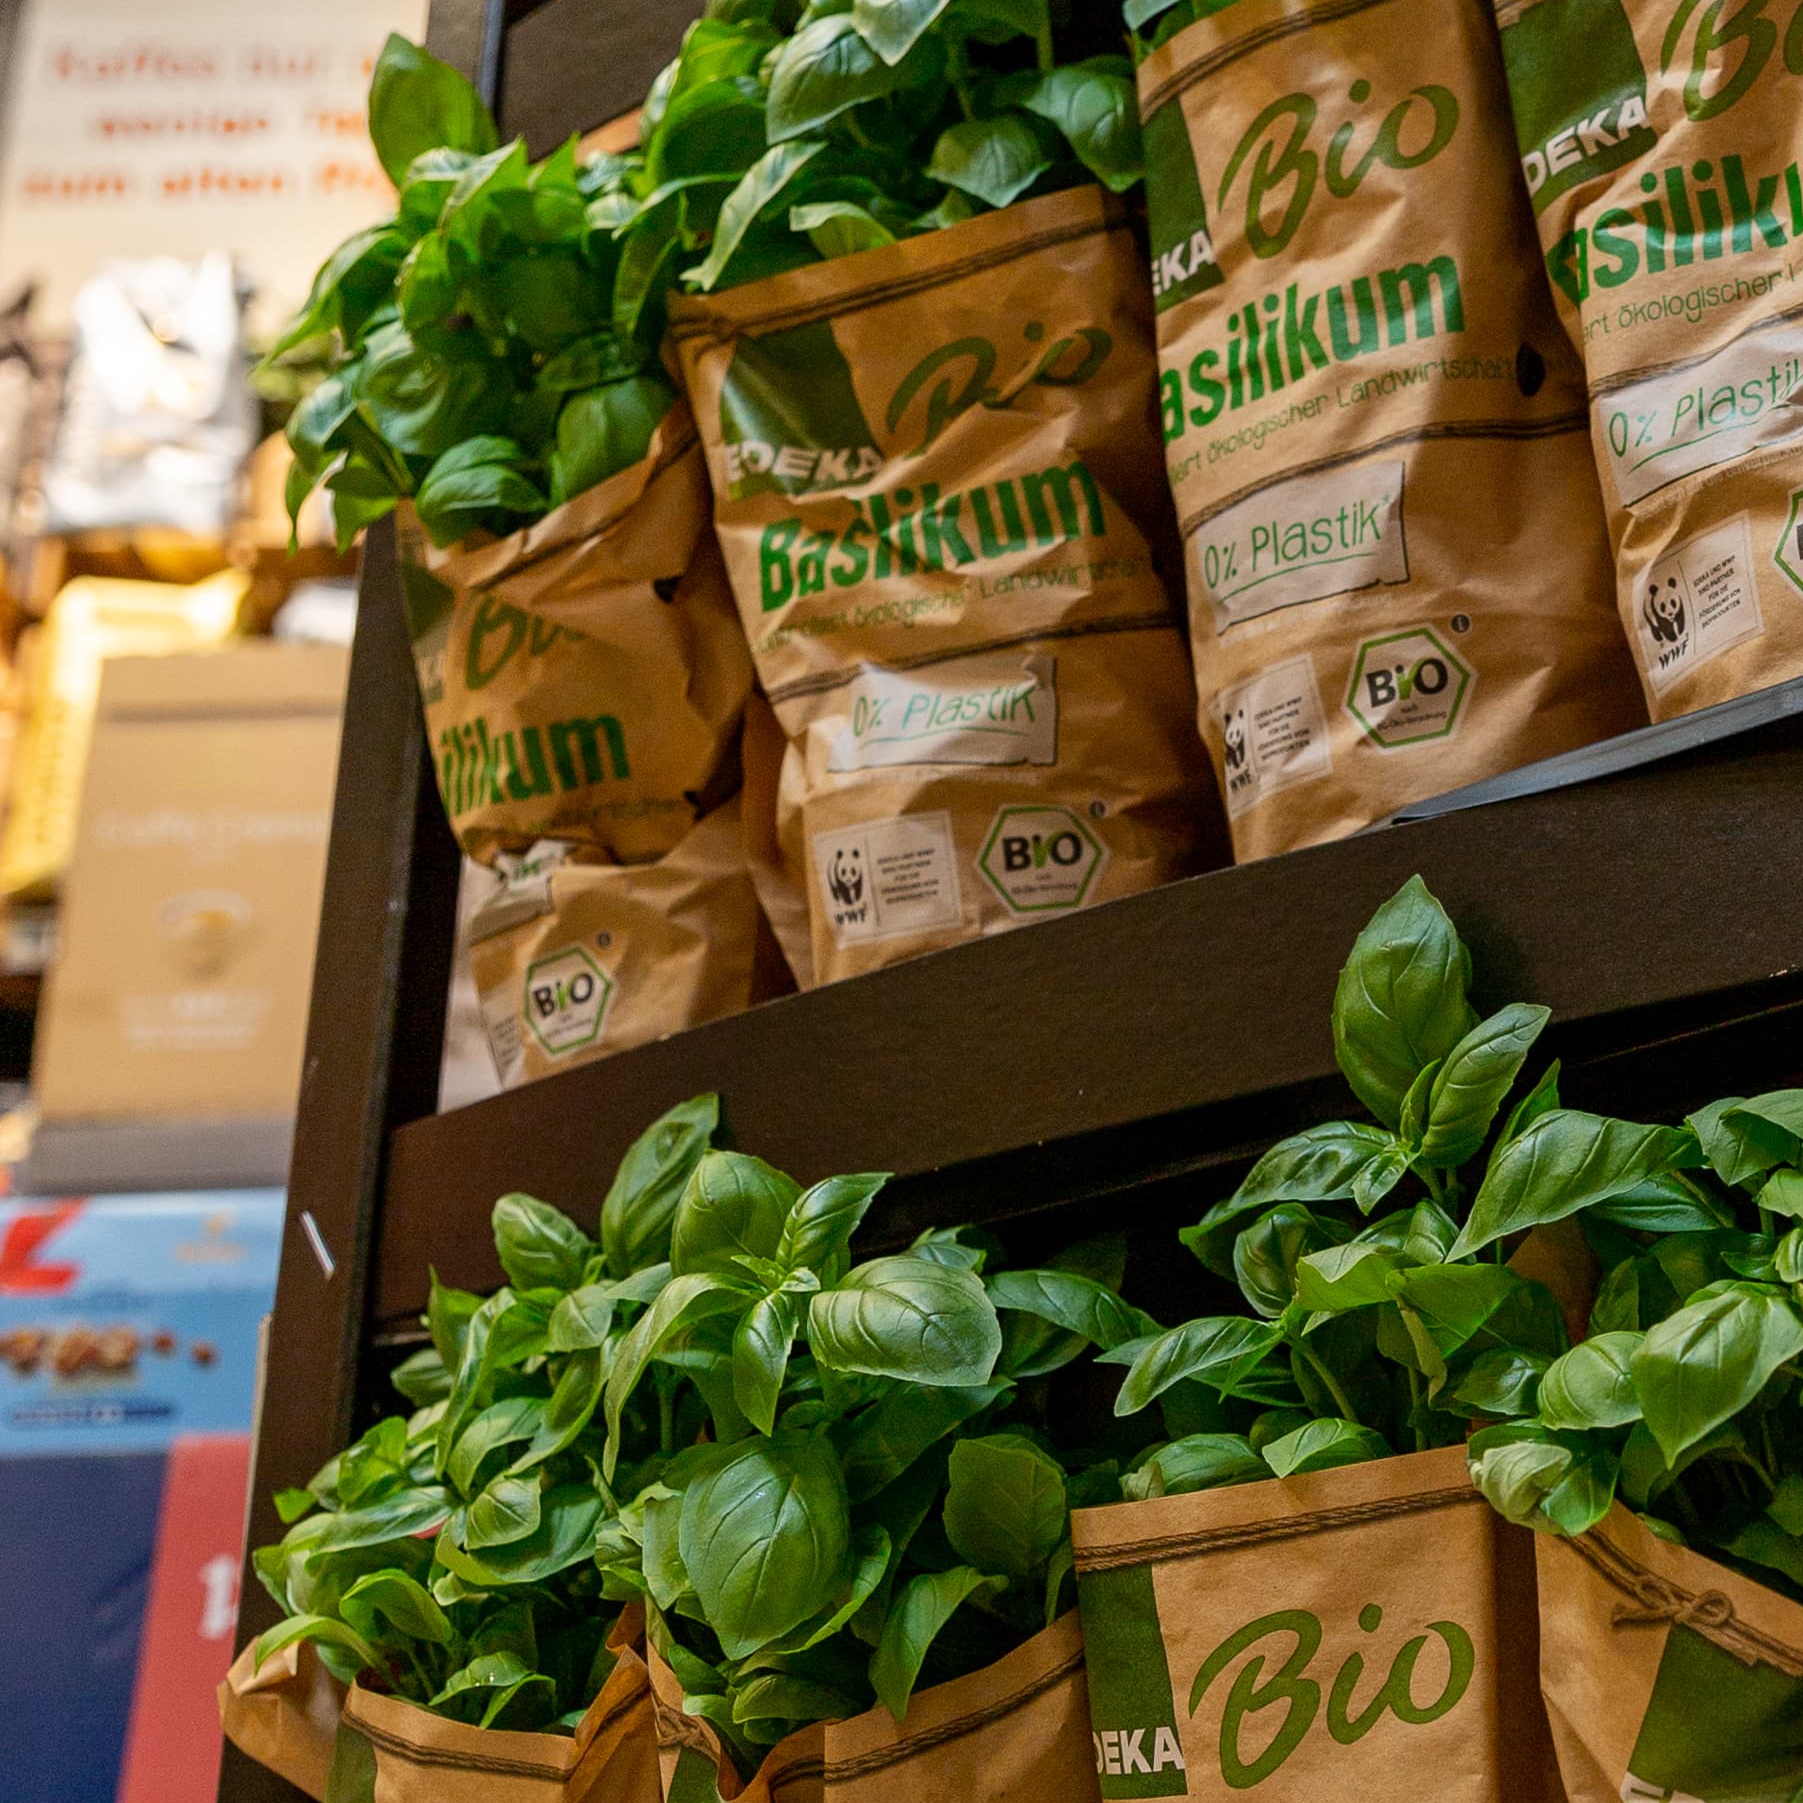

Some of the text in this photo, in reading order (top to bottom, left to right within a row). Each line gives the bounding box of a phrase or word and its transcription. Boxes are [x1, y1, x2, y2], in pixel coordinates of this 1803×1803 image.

[1217, 79, 1461, 260] Bio
[1524, 95, 1652, 193] DEKA
[1619, 269, 1784, 329] ökologischer
[1160, 255, 1466, 448] asilikum
[725, 441, 884, 484] EDEKA
[1608, 410, 1659, 458] 0%
[758, 461, 1106, 615] Baslikum
[1203, 543, 1239, 591] 0%
[1658, 640, 1689, 671] WWF
[852, 683, 1036, 738] 0% Plastik
[438, 715, 632, 819] ilikum
[1188, 1603, 1475, 1790] Bio
[1094, 1726, 1185, 1776] DEKA
